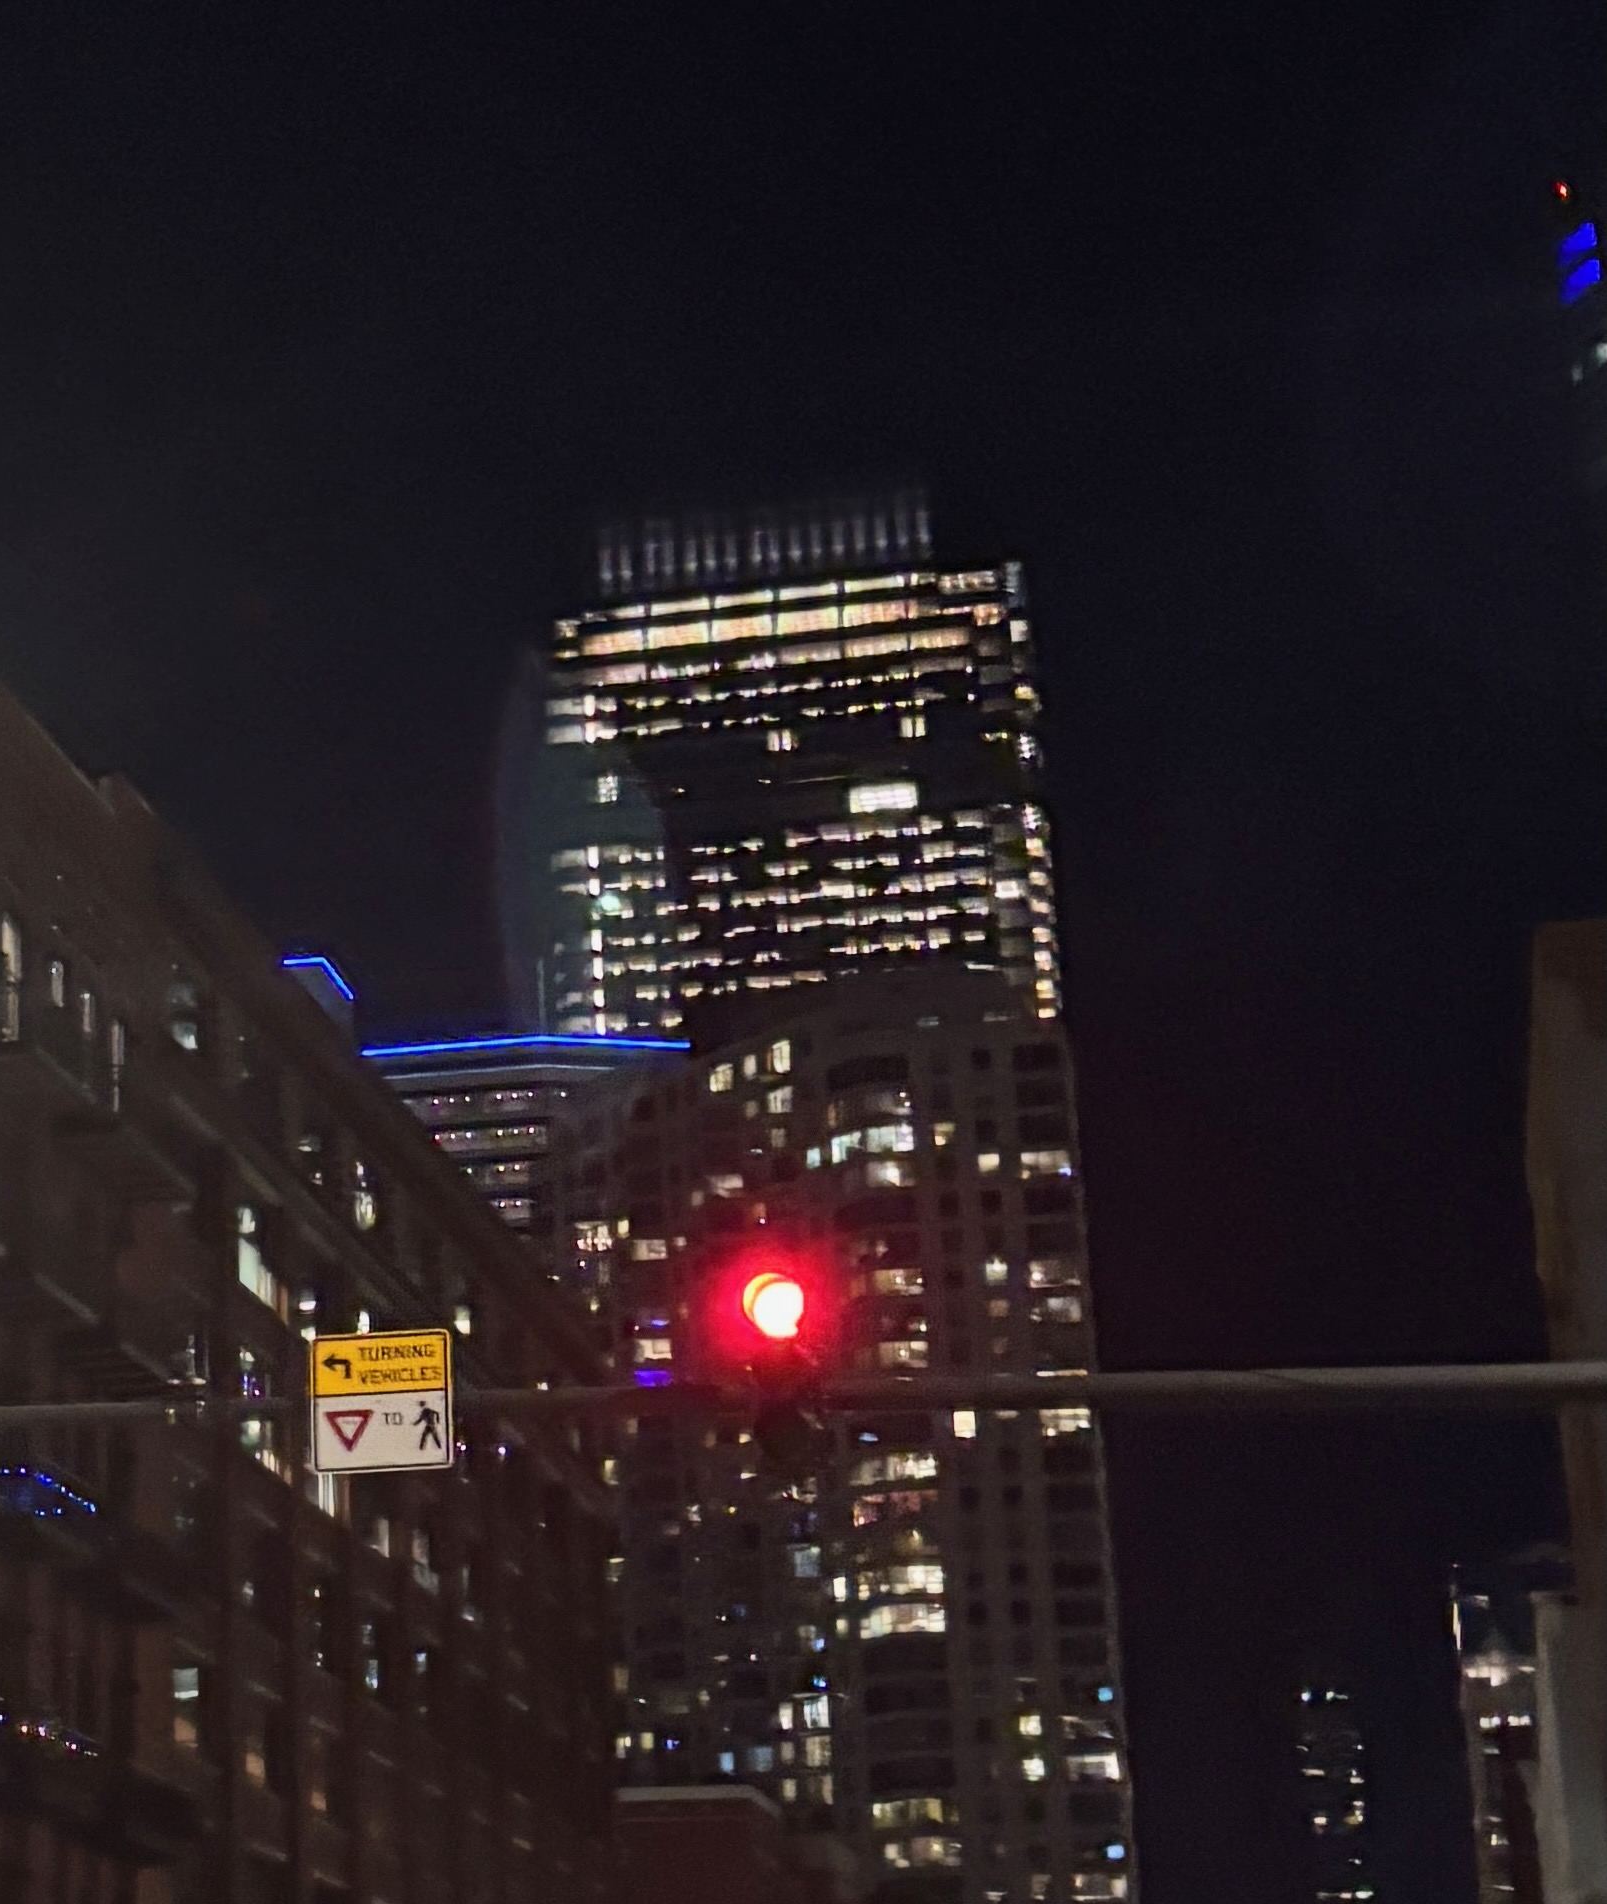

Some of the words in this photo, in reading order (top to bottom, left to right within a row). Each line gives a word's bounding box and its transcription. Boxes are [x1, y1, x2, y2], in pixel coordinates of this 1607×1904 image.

[358, 1344, 436, 1362] TURNING
[359, 1366, 443, 1385] VEHICLES
[382, 1412, 404, 1426] TO
